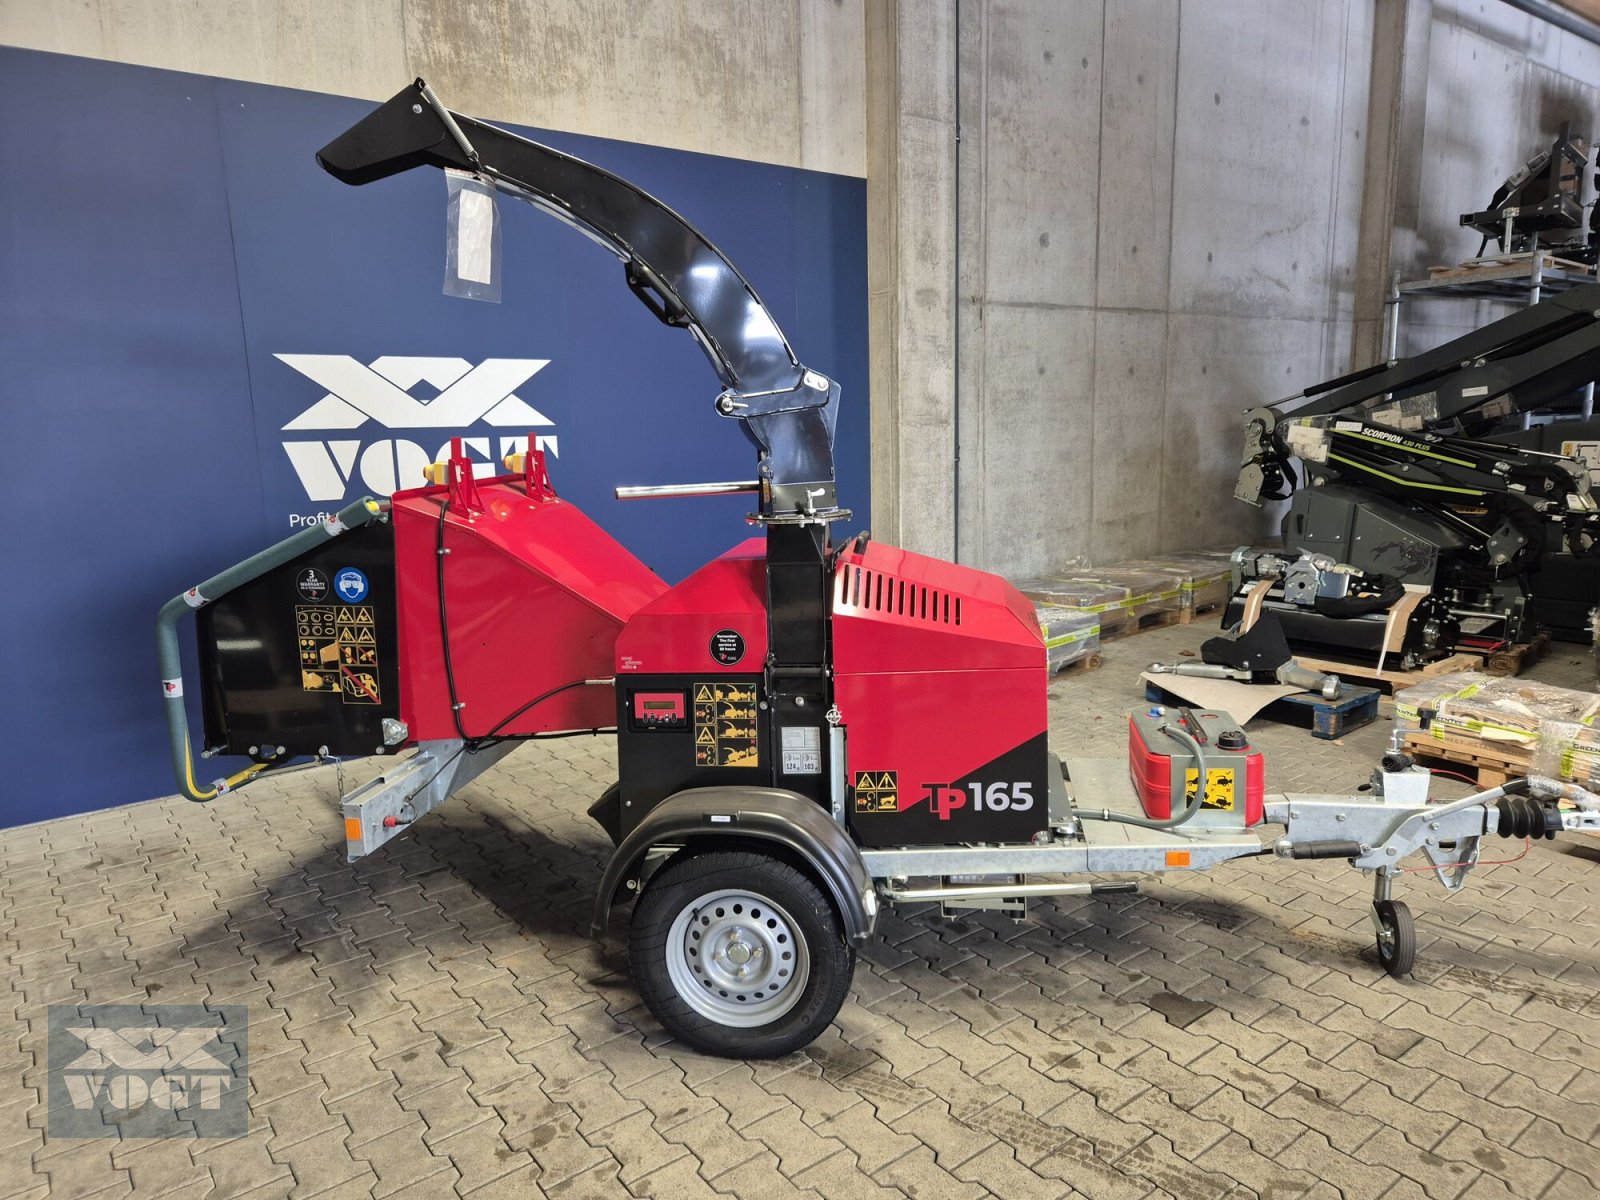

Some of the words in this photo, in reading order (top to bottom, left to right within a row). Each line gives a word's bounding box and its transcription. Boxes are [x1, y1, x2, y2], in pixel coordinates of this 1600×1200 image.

[1362, 427, 1404, 444] SCORPION
[1414, 442, 1431, 451] PLUS
[281, 435, 559, 502] VOGT
[308, 569, 315, 579] 3
[163, 682, 176, 692] TP
[968, 781, 1034, 812] 165
